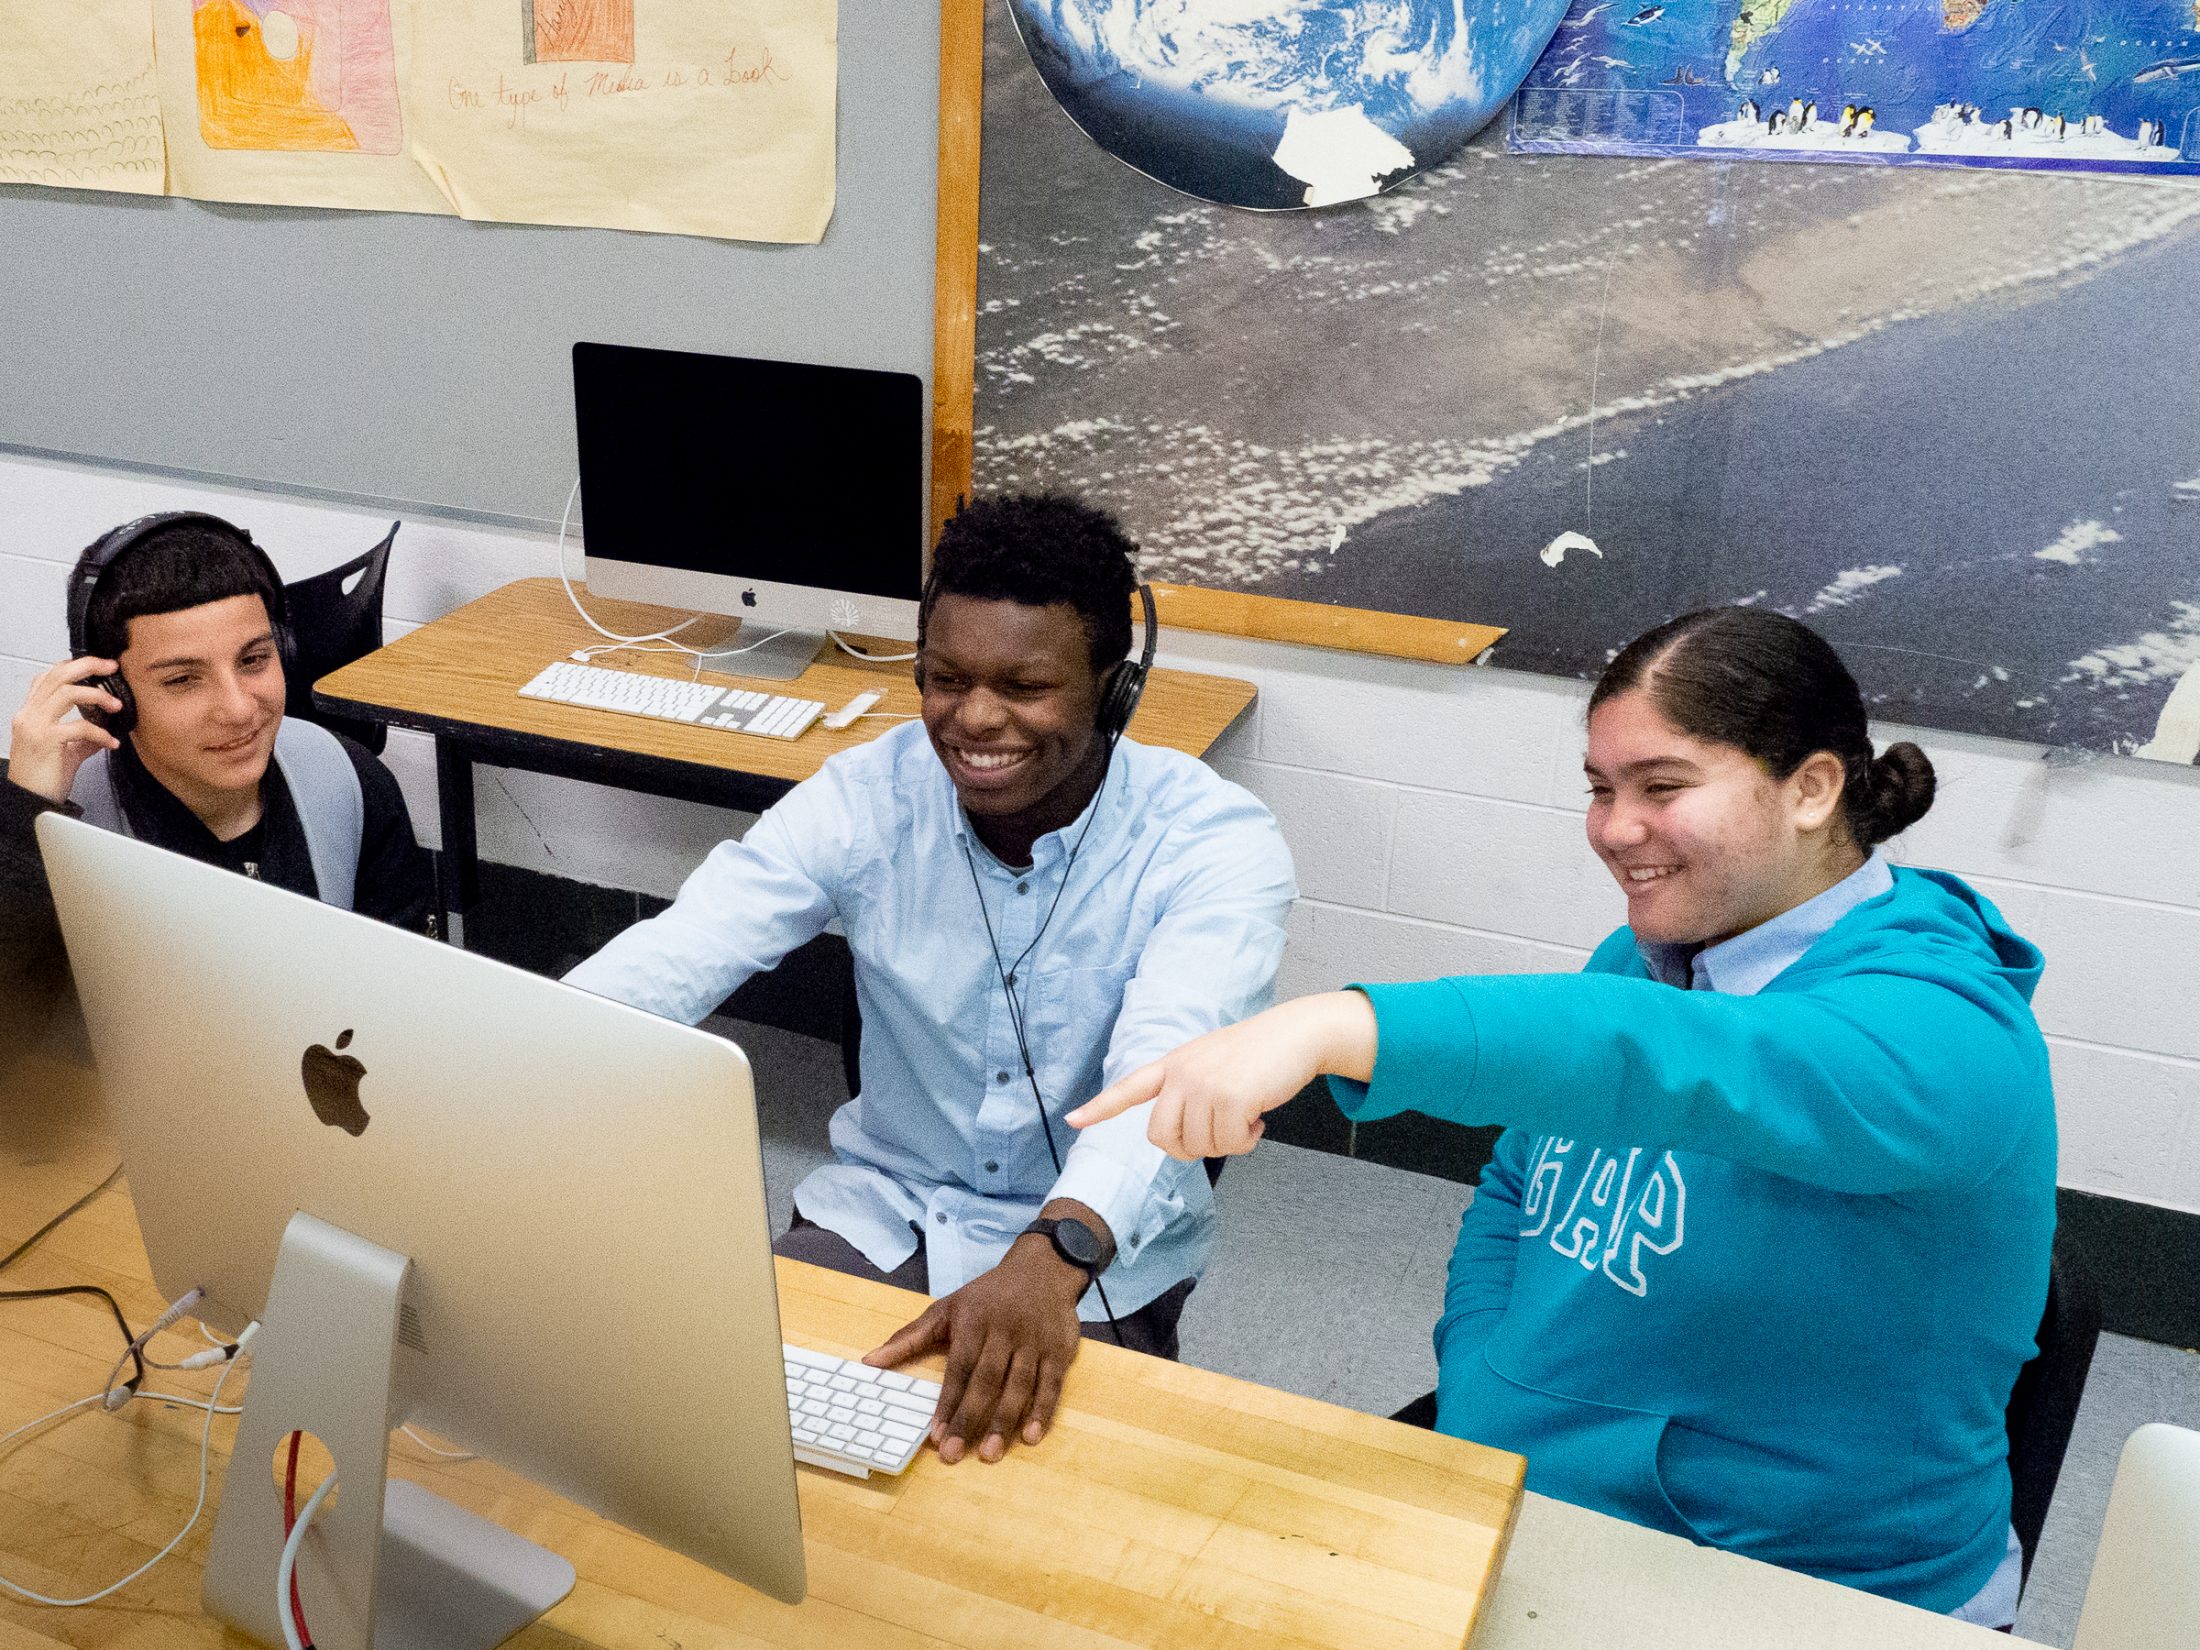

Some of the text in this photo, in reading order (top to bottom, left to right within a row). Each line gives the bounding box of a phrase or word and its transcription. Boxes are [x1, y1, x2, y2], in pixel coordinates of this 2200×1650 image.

[449, 76, 486, 111] One
[493, 73, 542, 130] type
[552, 72, 569, 112] of
[584, 63, 650, 97] Media
[663, 71, 688, 88] is
[697, 68, 713, 87] a
